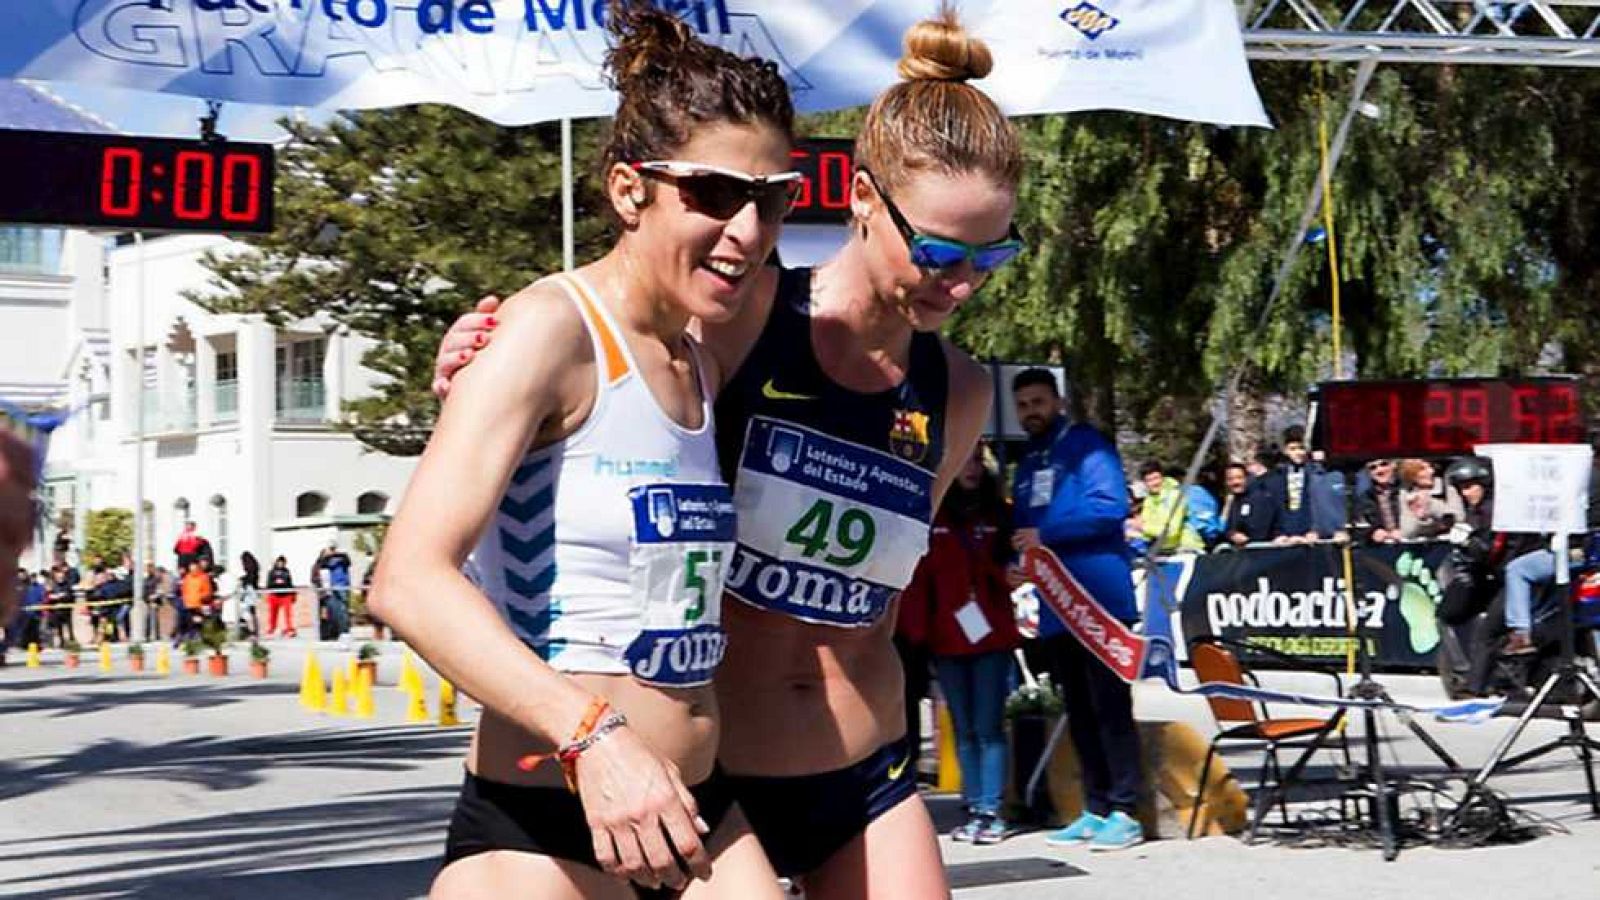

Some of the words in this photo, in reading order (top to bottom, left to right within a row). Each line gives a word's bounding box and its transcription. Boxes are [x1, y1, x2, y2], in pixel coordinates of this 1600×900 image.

[101, 146, 261, 222] 0:00
[803, 461, 822, 478] del
[824, 468, 868, 492] Estado
[785, 499, 876, 567] 49
[727, 549, 871, 615] Joma
